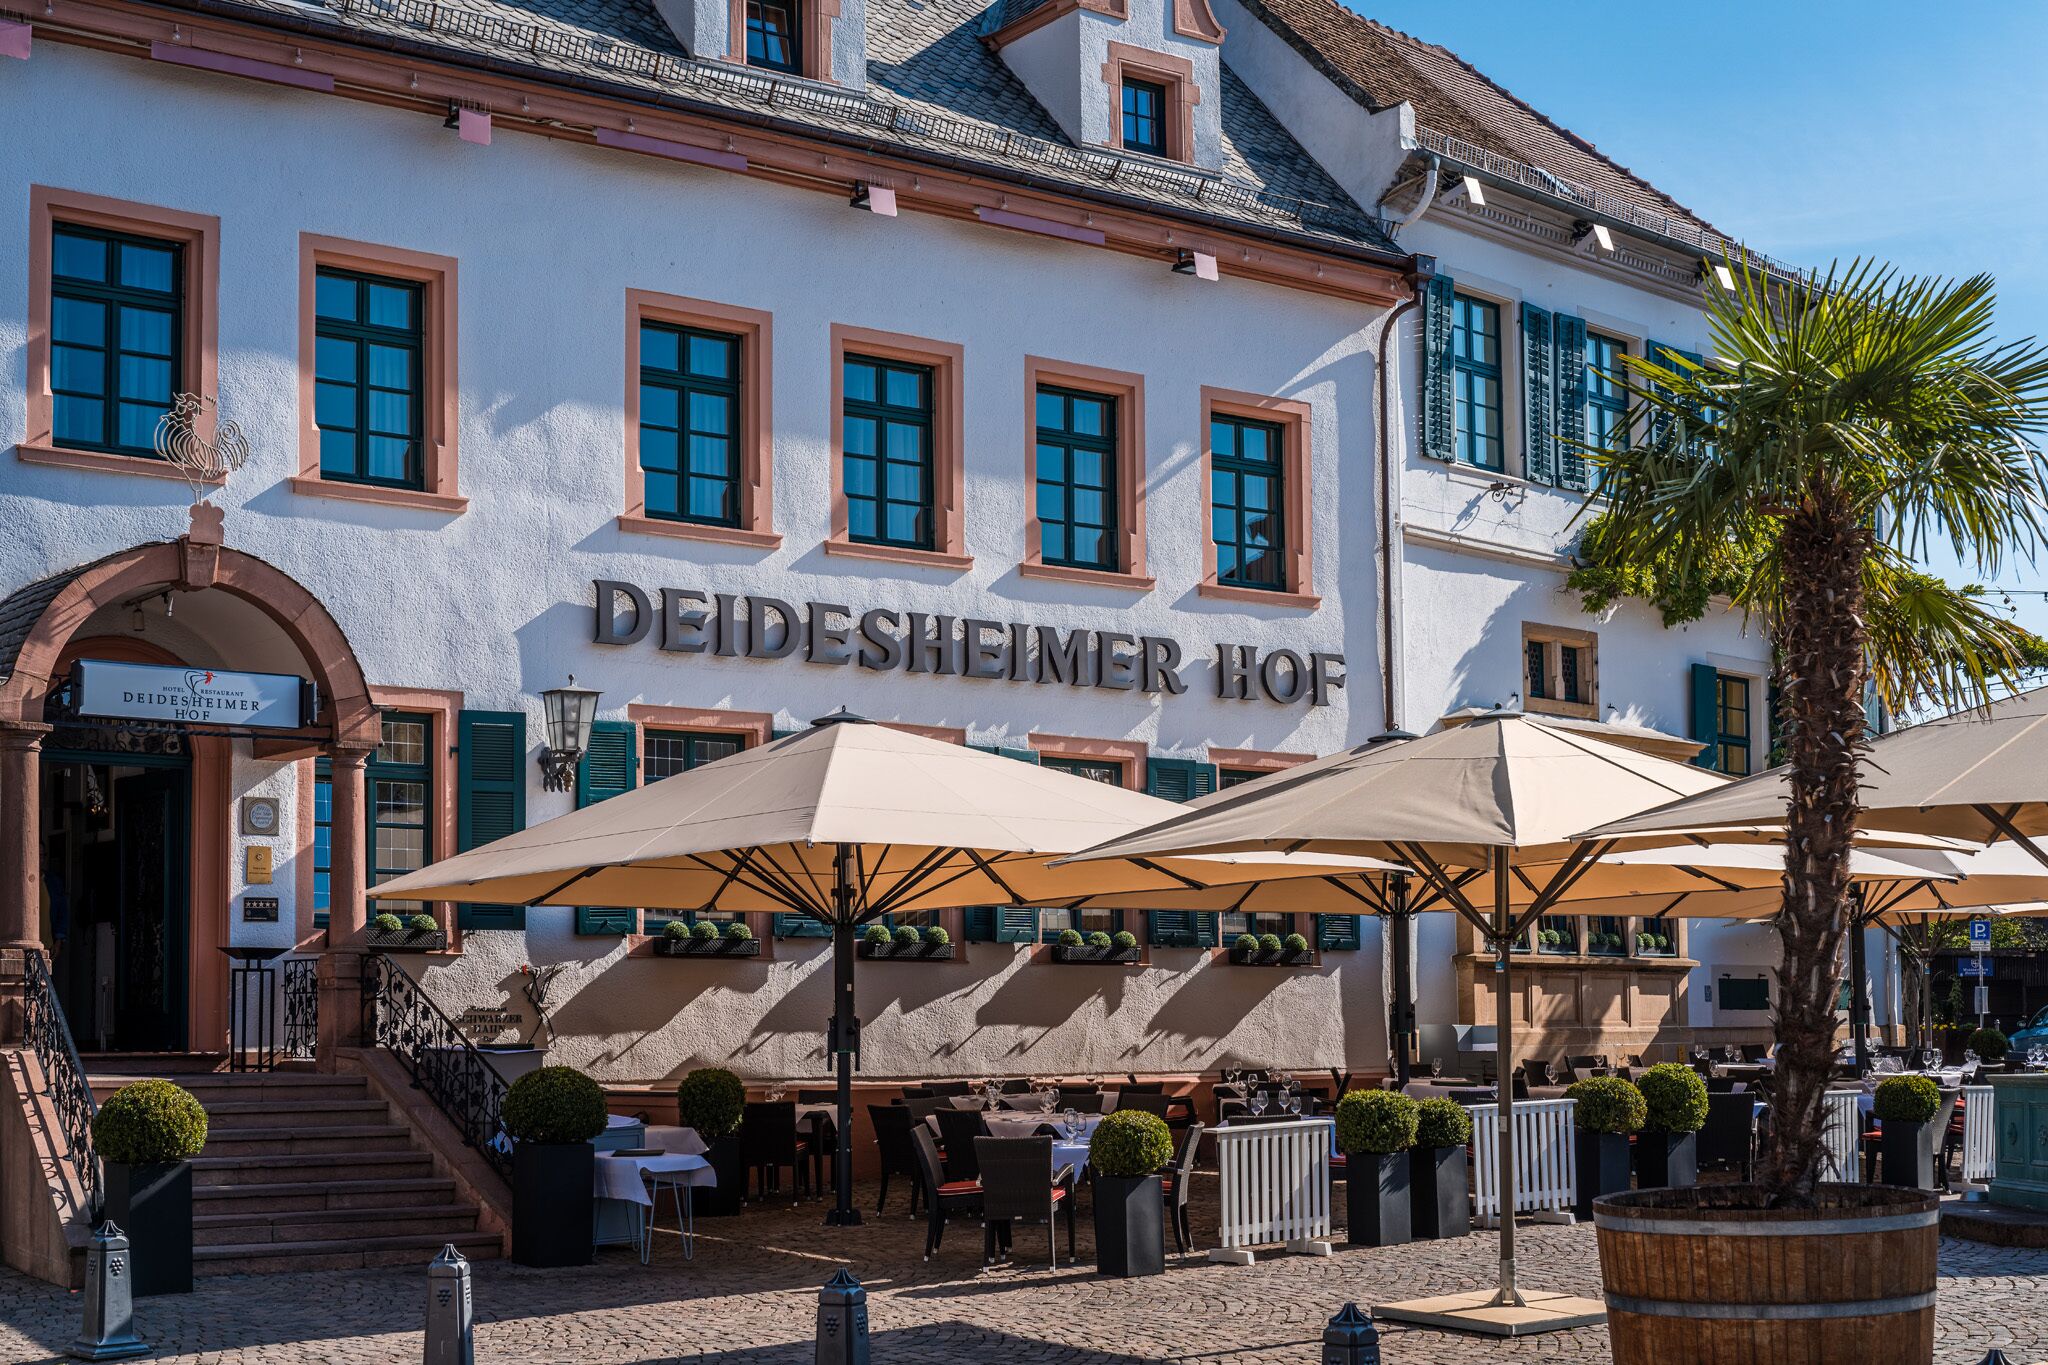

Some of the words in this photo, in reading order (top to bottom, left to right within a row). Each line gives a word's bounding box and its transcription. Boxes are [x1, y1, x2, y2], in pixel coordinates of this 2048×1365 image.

[592, 579, 1189, 695] DEIDESHEIMER
[1215, 642, 1347, 707] HOF
[200, 688, 245, 698] RESTAURANT
[123, 691, 260, 711] DEIDESHEIMER
[174, 709, 211, 721] HOF
[1974, 923, 1986, 938] P
